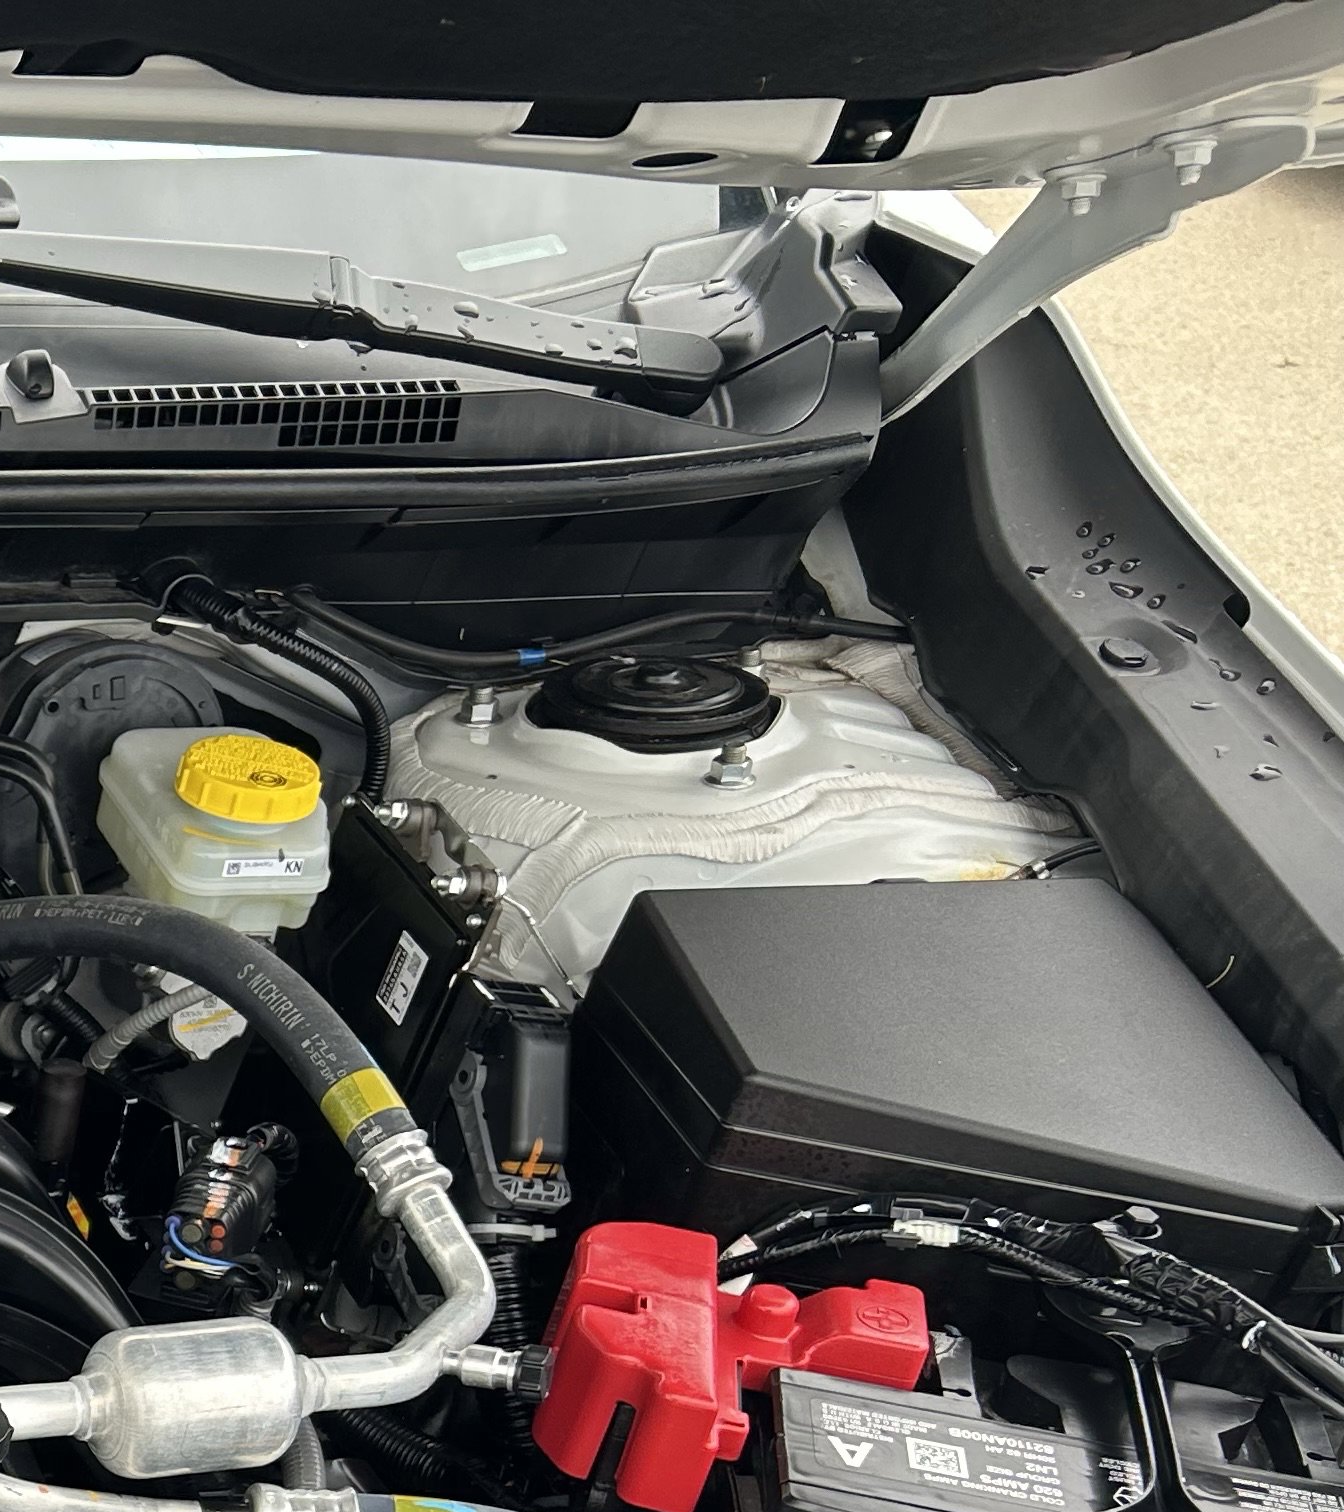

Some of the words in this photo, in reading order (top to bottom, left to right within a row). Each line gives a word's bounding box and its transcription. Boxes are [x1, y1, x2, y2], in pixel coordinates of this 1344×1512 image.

[284, 860, 304, 874] KN
[1025, 1462, 1058, 1476] LN2
[923, 1473, 959, 1486] AMPS
[979, 1474, 1029, 1491] AMPS
[1016, 1472, 1061, 1485] GROUP
[962, 1480, 1028, 1499] CRANKING
[1033, 1484, 1063, 1497] 620
[1029, 1493, 1065, 1506] COLD
